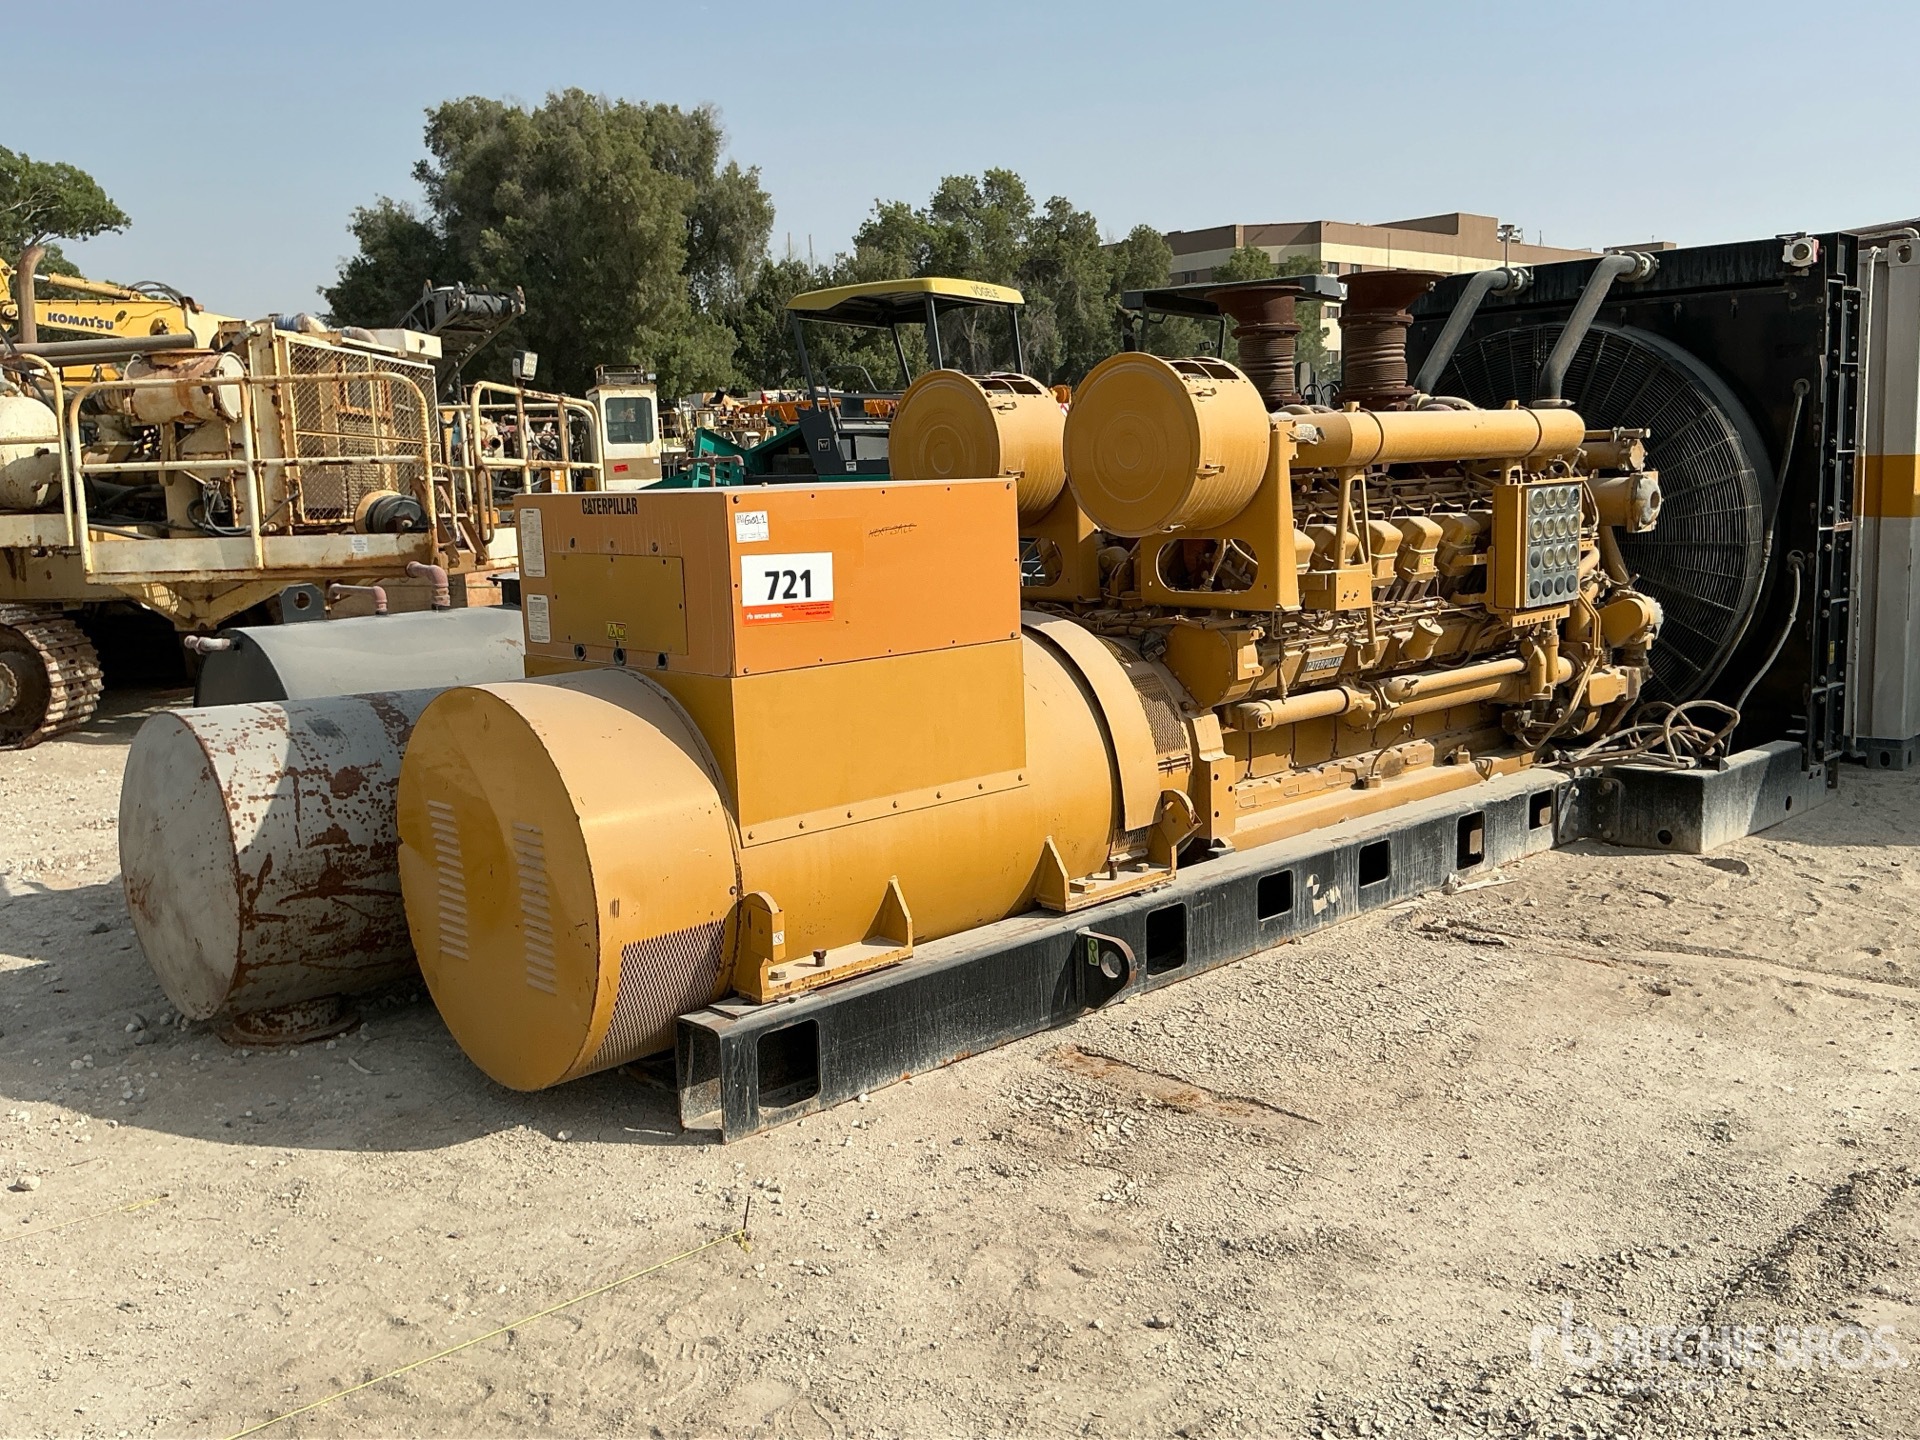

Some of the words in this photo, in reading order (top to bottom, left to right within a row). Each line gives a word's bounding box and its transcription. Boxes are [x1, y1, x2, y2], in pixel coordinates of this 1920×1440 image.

[47, 312, 113, 330] KOMATSU
[581, 497, 638, 515] CATERPILLAR
[765, 569, 811, 600] 721
[1305, 656, 1345, 671] CATERPILLAR
